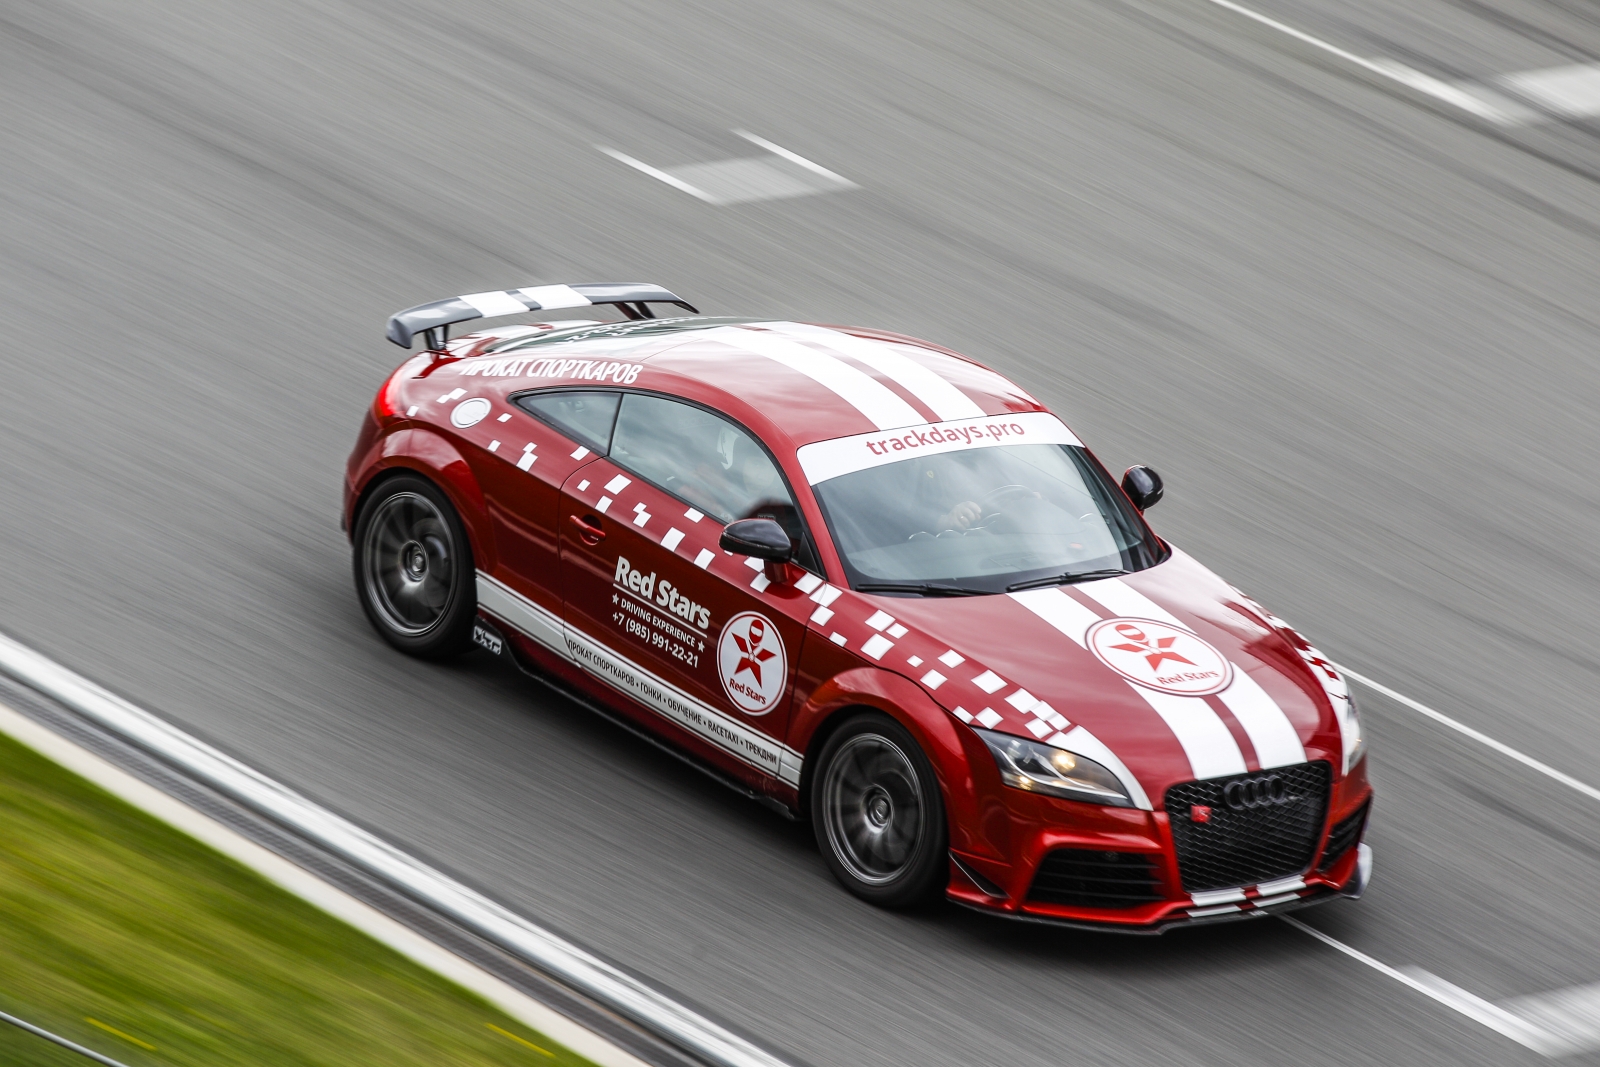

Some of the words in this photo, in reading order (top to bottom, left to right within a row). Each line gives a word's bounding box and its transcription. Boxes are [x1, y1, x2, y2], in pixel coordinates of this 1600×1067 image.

[459, 358, 532, 377] ПРОКАТ
[526, 358, 643, 385] СПОРТКАРОВ
[866, 421, 1025, 456] trackdays.pro
[614, 555, 656, 599] Red
[656, 580, 711, 630] Stars
[612, 611, 626, 627] +7
[625, 618, 651, 643] (985)
[652, 632, 699, 669] 991-22-21
[620, 598, 651, 623] DRIVING
[652, 617, 696, 647] EXPERIENCE
[568, 639, 592, 662] ПРОКАТ
[593, 653, 635, 687] СПОРТКАРОВ
[640, 682, 662, 703] ГОНКИ
[667, 698, 702, 726] ОБУЧЕНИЕ
[707, 720, 739, 746] RACETAXI
[729, 678, 746, 695] Red
[745, 686, 767, 705] Stars
[1156, 674, 1185, 685] Red
[1184, 671, 1219, 681] Stars
